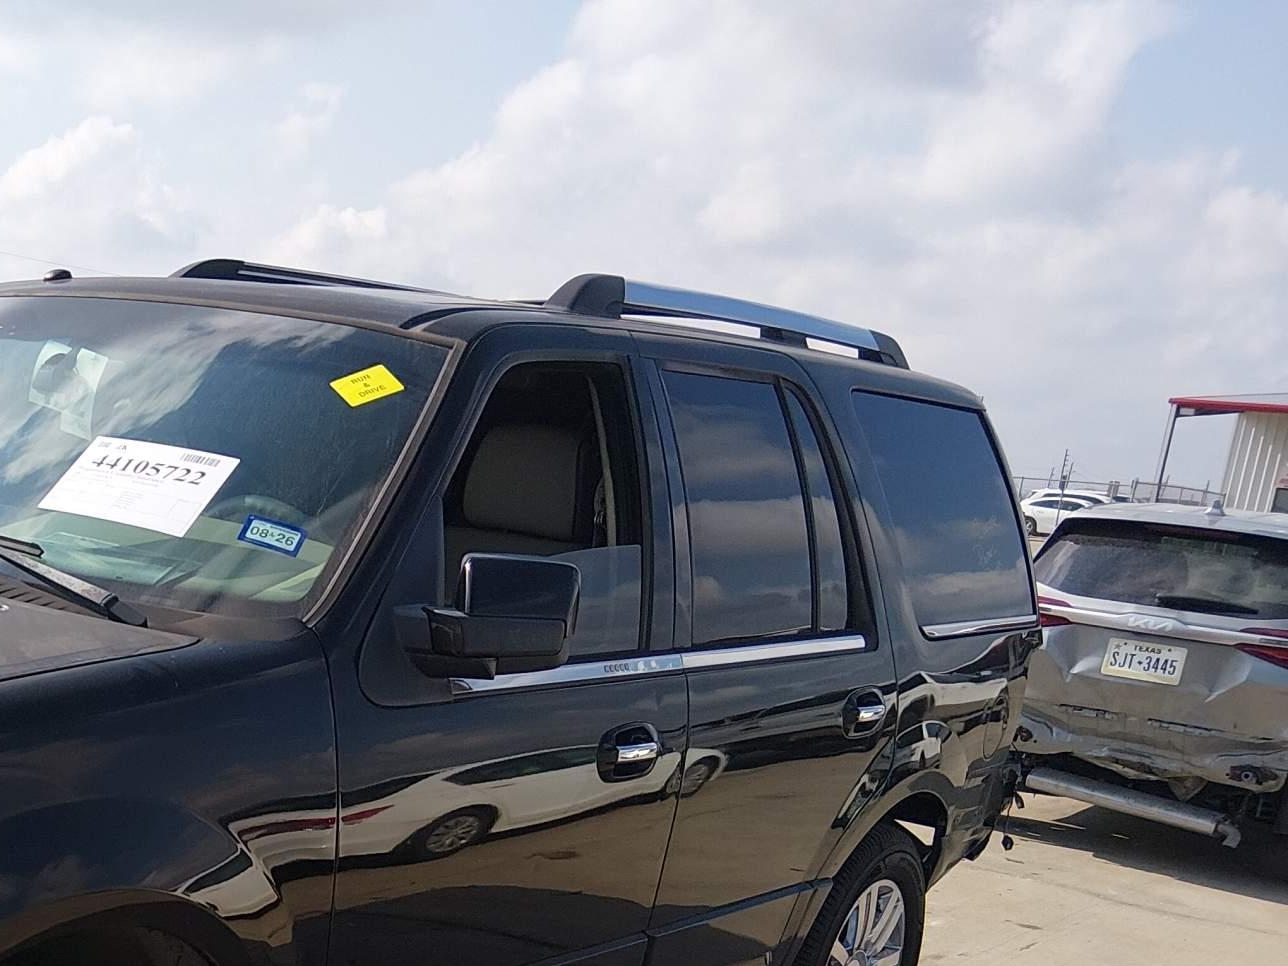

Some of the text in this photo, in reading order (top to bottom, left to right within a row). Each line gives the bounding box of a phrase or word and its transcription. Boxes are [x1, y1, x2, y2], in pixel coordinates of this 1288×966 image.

[351, 374, 372, 385] RUN
[358, 384, 387, 398] DRIVE
[92, 454, 207, 486] 44105722
[249, 526, 270, 539] 08
[275, 532, 296, 547] 26
[1133, 644, 1163, 655] TEXAS
